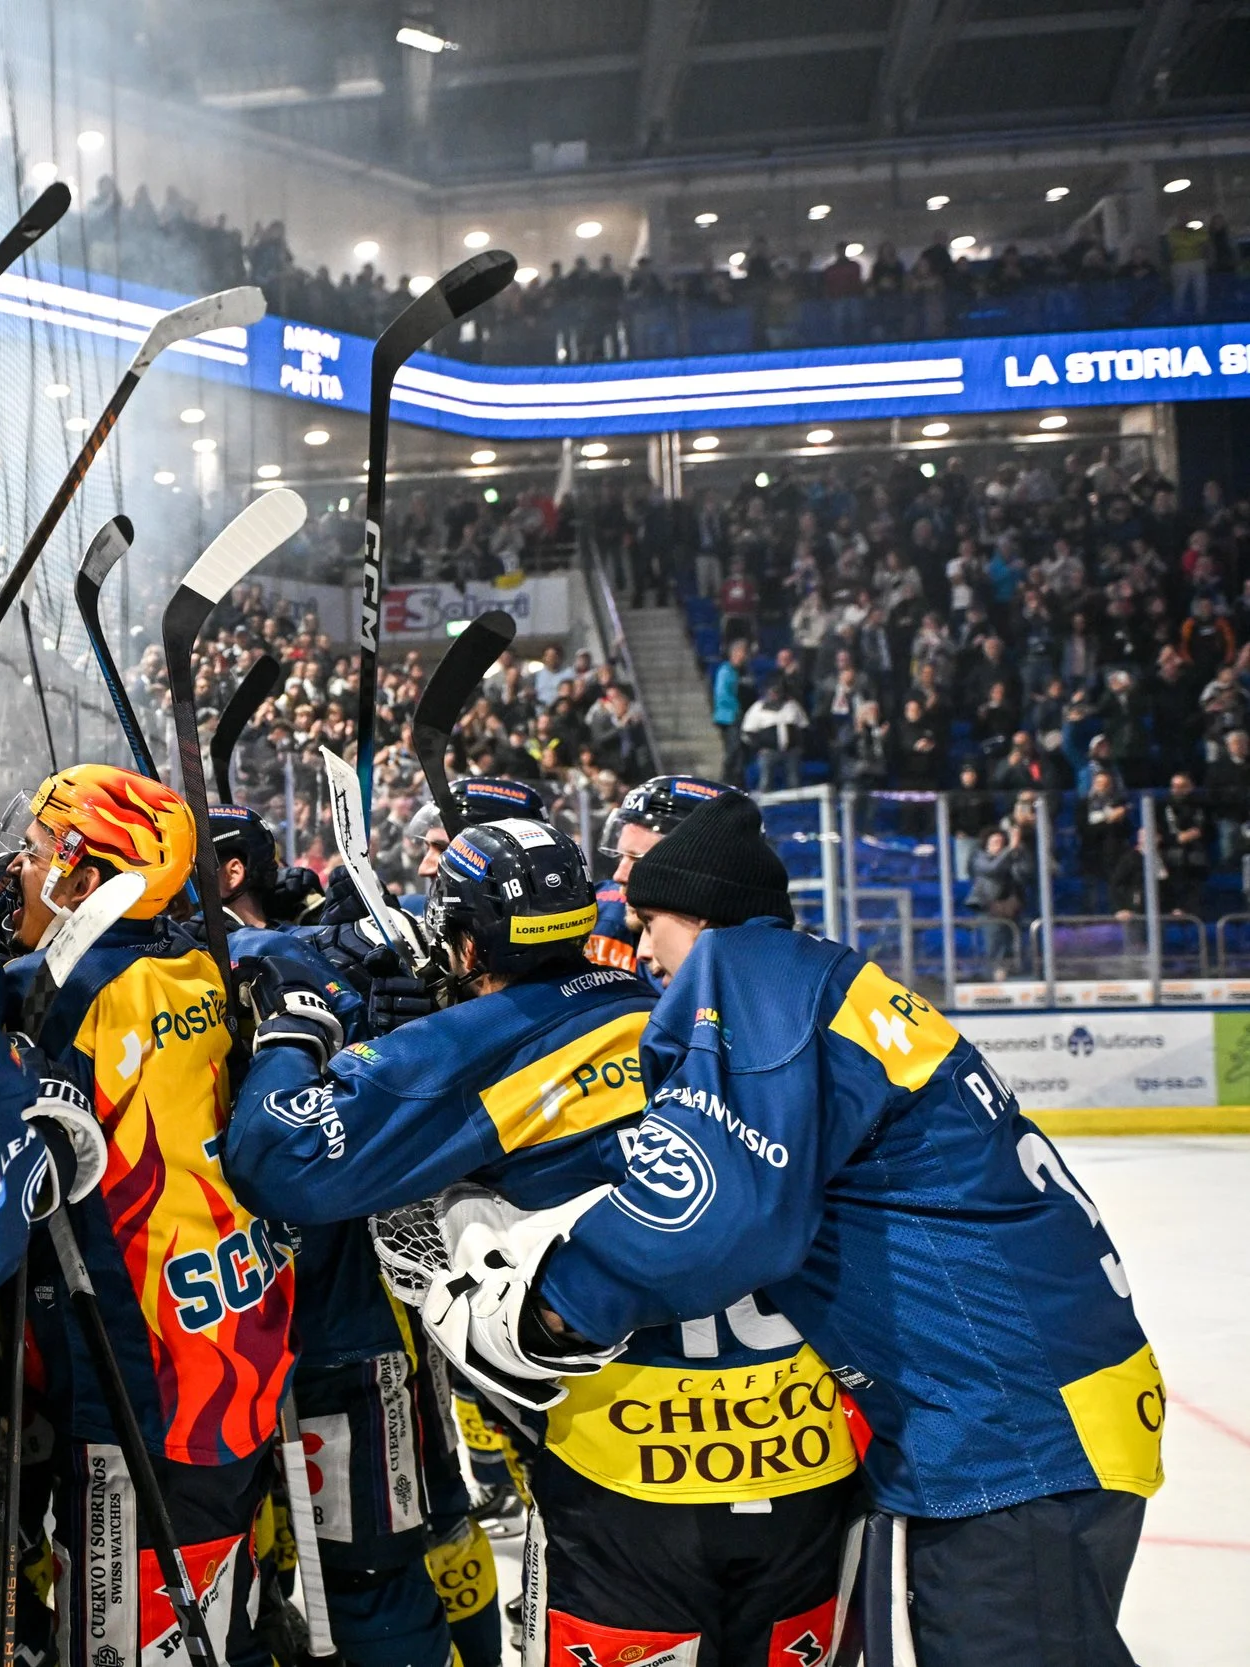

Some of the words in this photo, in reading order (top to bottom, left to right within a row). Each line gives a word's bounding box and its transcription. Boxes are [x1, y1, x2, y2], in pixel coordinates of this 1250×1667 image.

[1004, 354, 1059, 387] LA
[1065, 346, 1212, 383] STORIA
[361, 519, 381, 653] CCM
[502, 878, 524, 899] 18
[516, 925, 544, 935] LORIS
[976, 1034, 1046, 1053] rsonnel
[608, 1371, 837, 1435] CHICCO
[388, 1409, 399, 1472] CUERVO
[638, 1425, 831, 1485] D'ORO
[91, 1457, 106, 1546] SOBRINOS
[110, 1493, 122, 1559] WATCHES
[91, 1550, 106, 1561] Y
[110, 1559, 123, 1605] SWISS
[531, 1541, 540, 1597] WATCHES
[91, 1564, 106, 1639] CUERVO
[527, 1598, 537, 1641] SWISS
